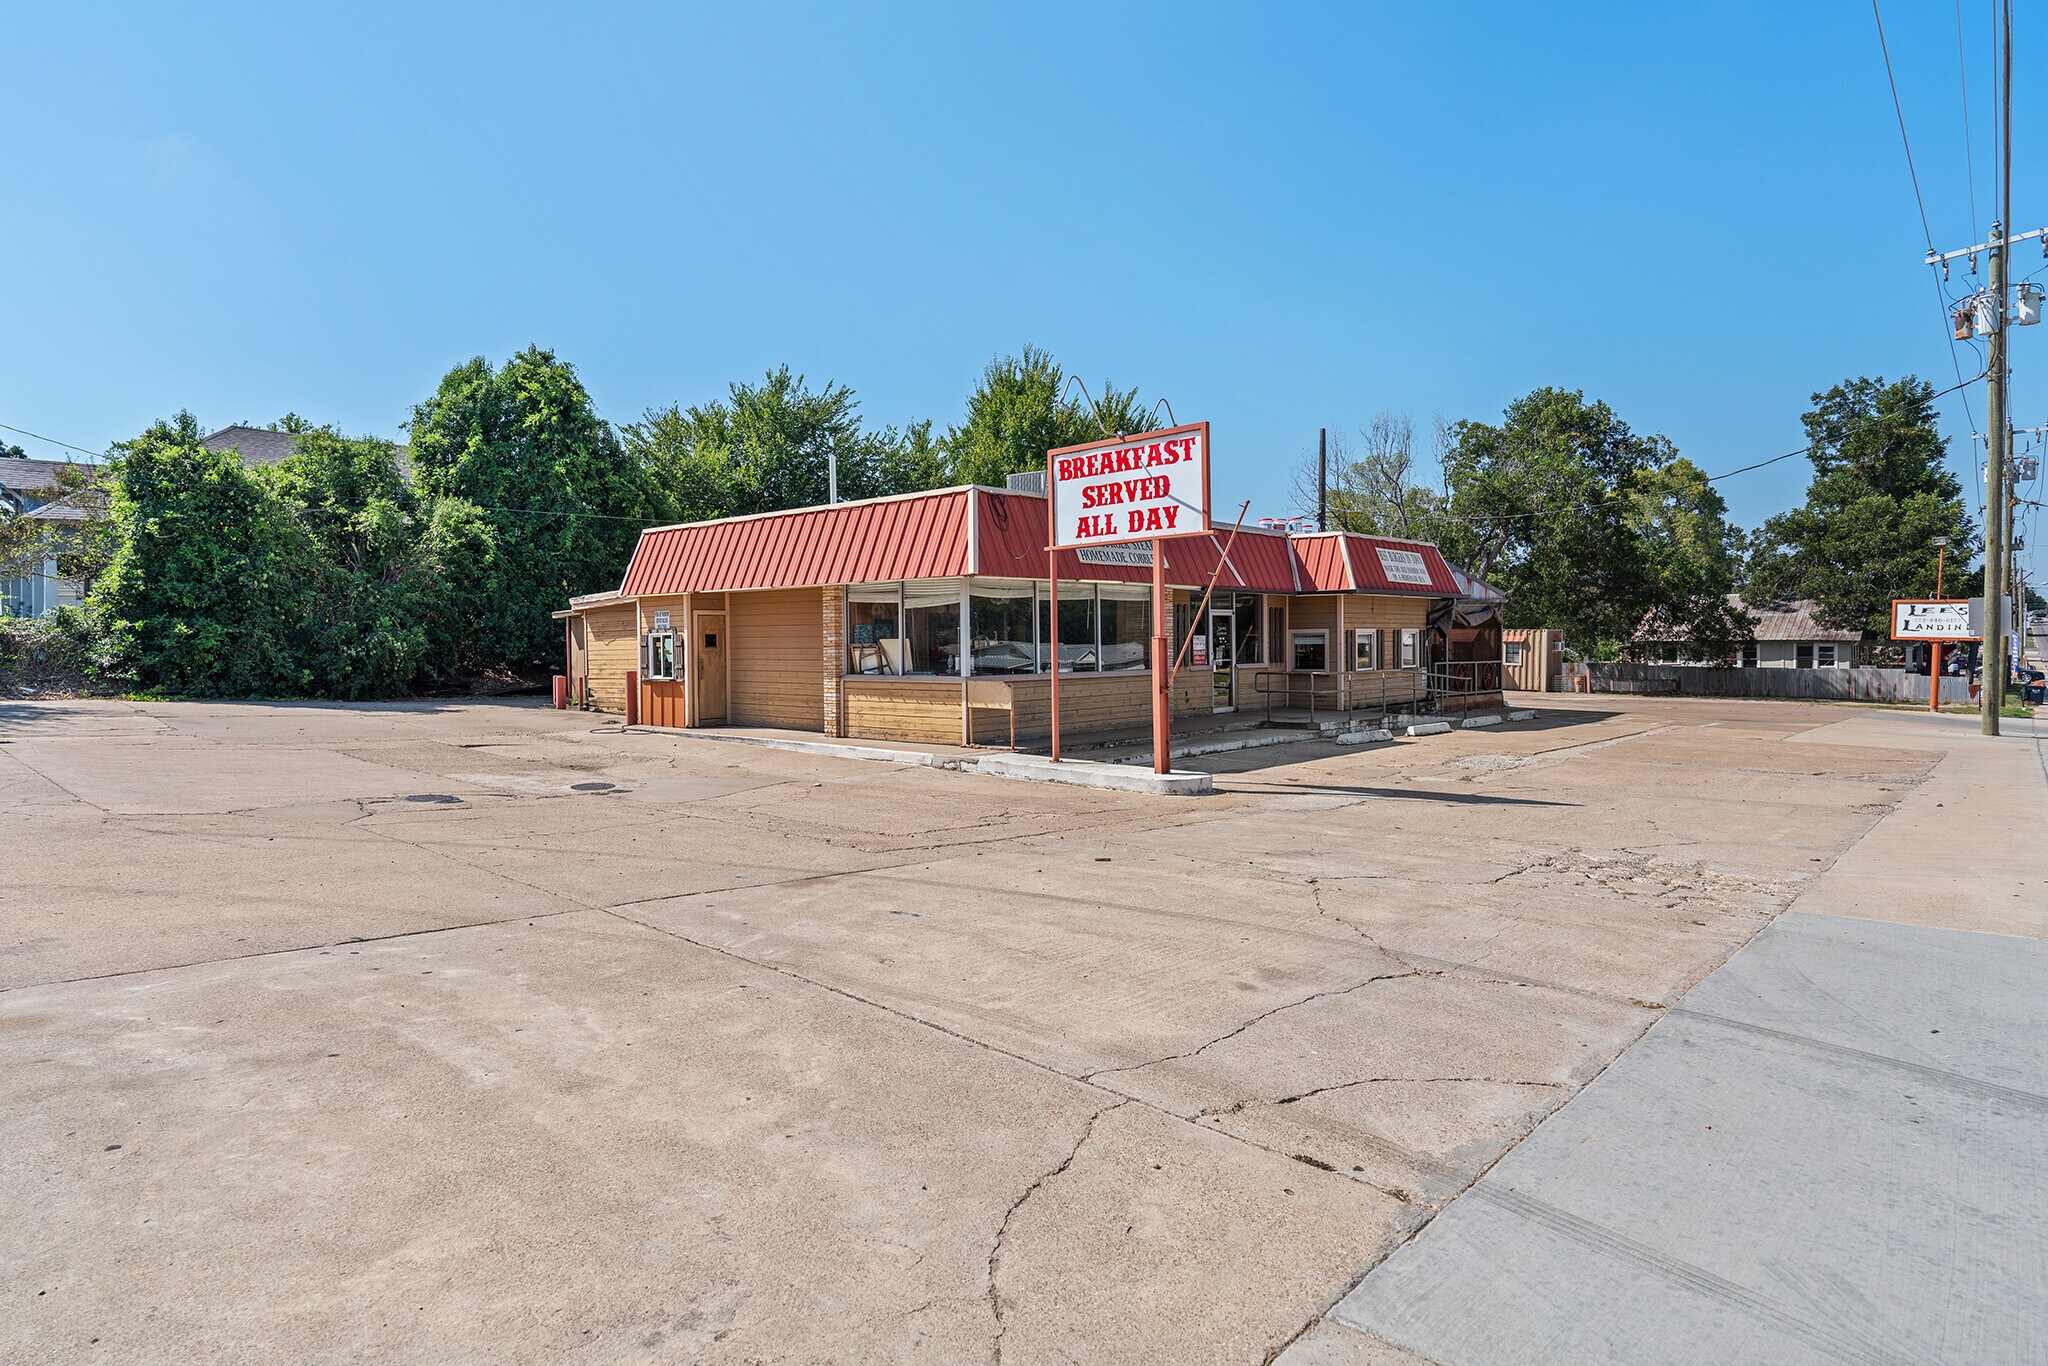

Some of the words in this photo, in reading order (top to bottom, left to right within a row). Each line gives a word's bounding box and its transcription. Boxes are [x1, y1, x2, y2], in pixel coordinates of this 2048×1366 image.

[1058, 437, 1196, 481] BREAKFAST
[1082, 475, 1171, 509] SERVED
[1075, 513, 1117, 539] ALL
[1128, 505, 1179, 533] DAY
[1079, 549, 1128, 563] HOMEMADE
